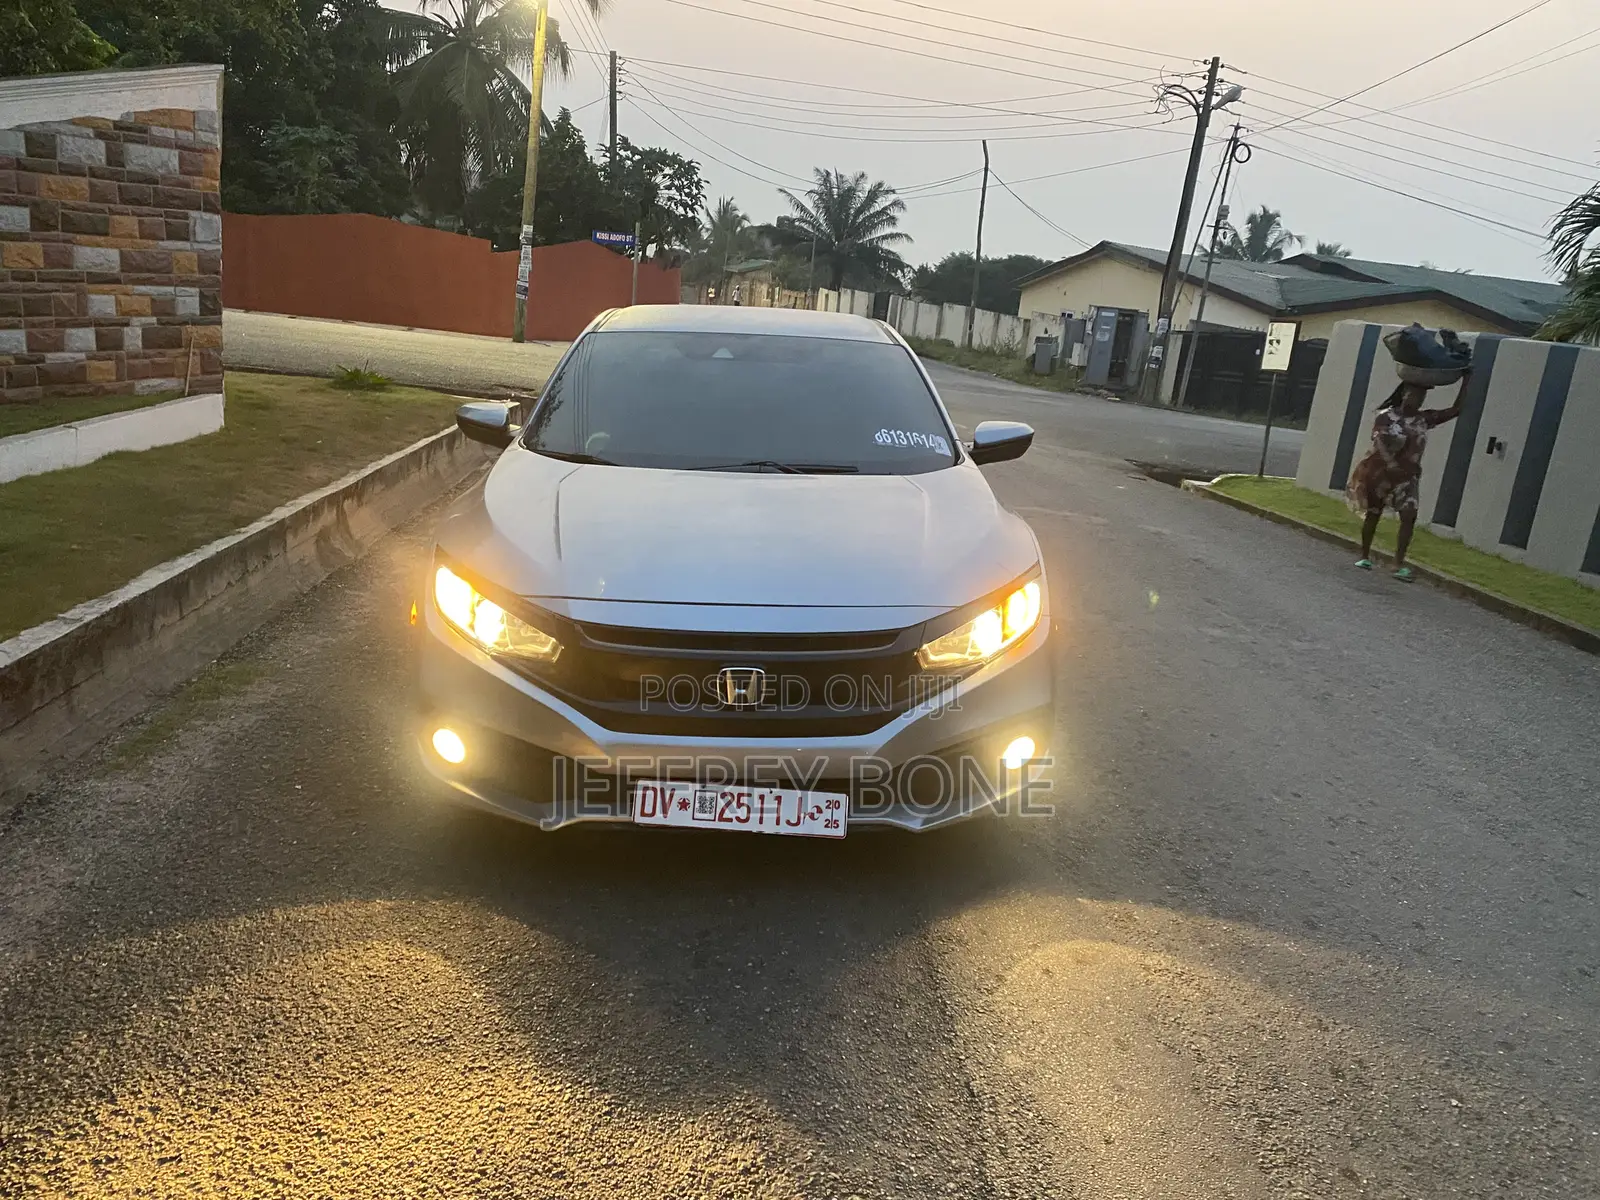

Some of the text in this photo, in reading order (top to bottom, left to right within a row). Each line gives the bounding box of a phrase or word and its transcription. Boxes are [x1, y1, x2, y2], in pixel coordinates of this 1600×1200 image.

[596, 232, 610, 240] KISSI
[610, 233, 626, 241] ADOFO
[640, 786, 676, 818] DV
